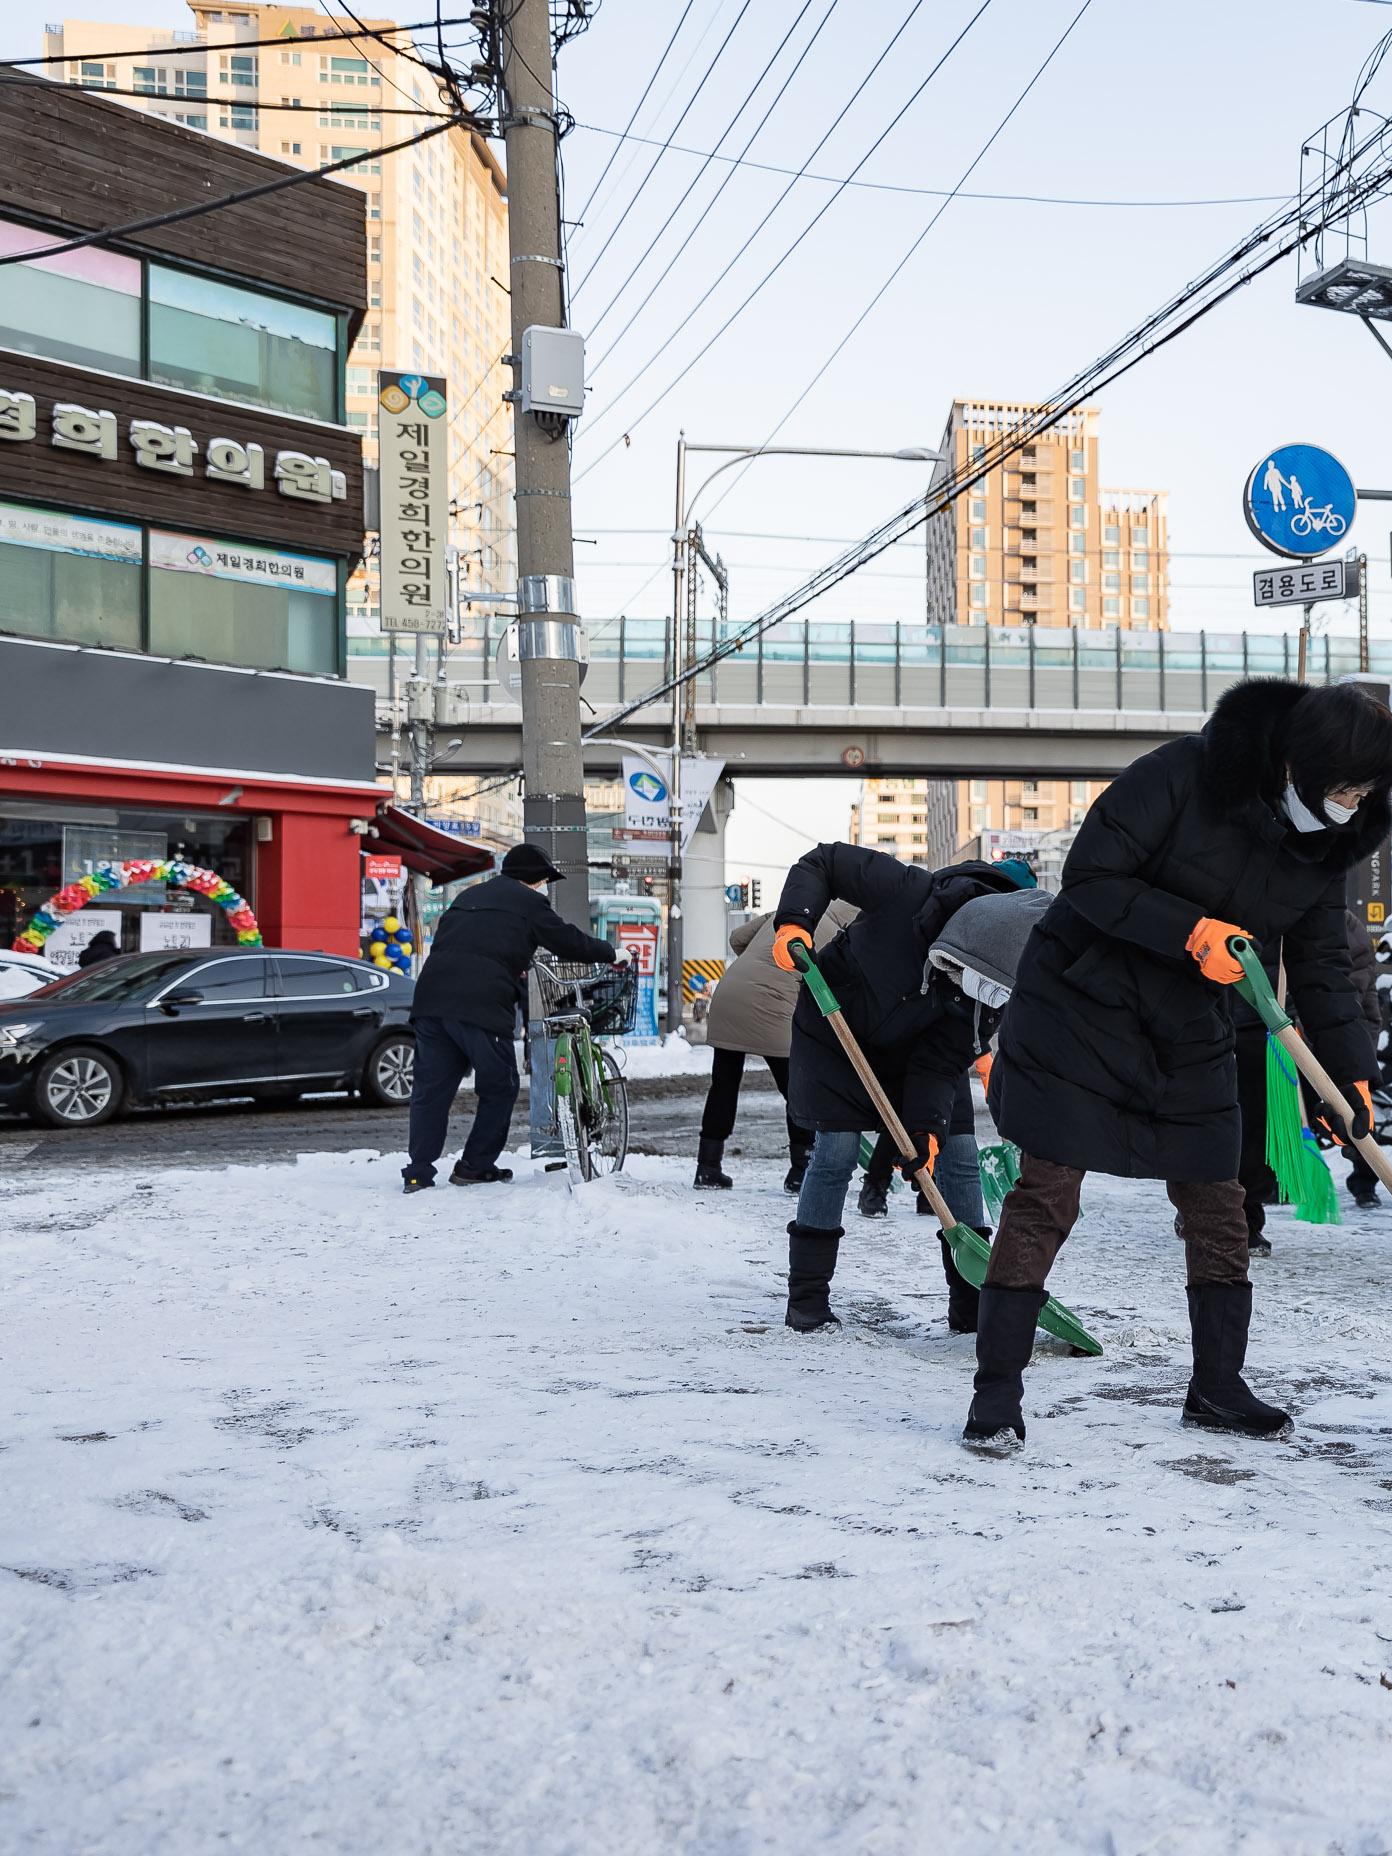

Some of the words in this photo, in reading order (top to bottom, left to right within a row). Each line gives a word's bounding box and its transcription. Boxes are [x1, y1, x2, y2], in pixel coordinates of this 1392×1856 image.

[396, 422, 435, 607] 제일경희한의원
[215, 551, 305, 580] 제일경희한의원
[1258, 569, 1338, 600] 겸용도로
[385, 616, 399, 628] TEL
